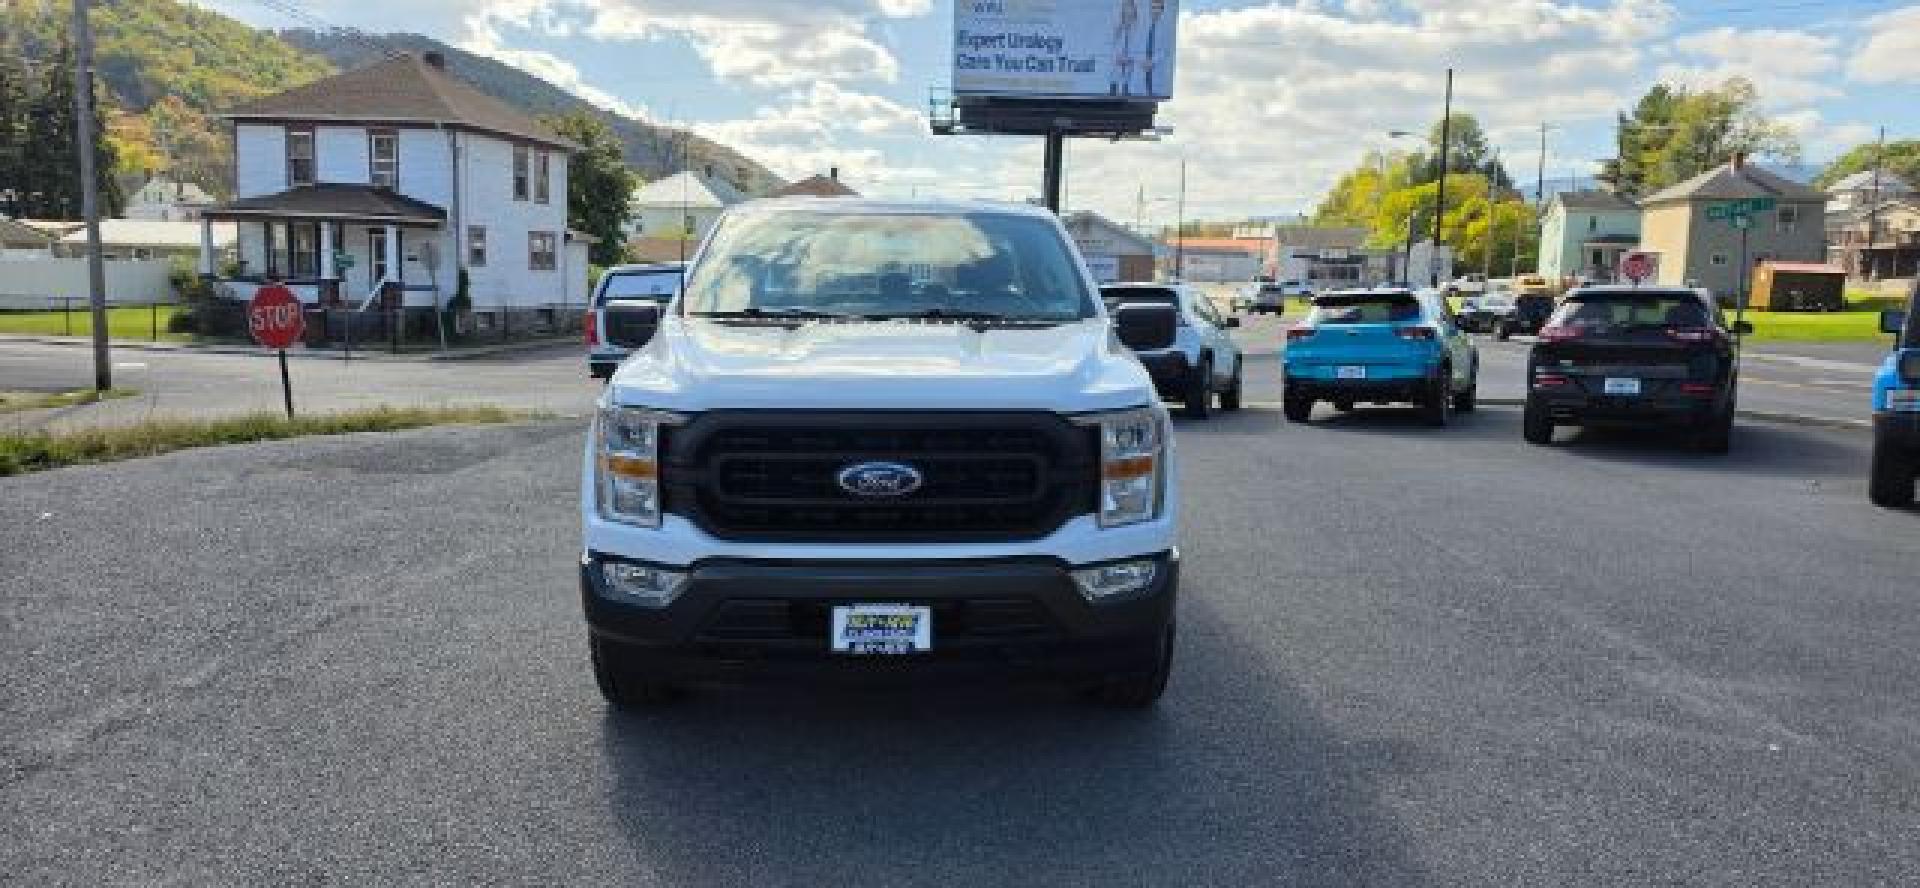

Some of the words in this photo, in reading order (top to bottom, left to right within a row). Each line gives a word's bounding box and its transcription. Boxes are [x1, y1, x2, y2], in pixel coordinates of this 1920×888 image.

[959, 31, 1006, 50] Expert
[1008, 33, 1063, 53] Urology
[958, 54, 991, 70] Care
[995, 54, 1023, 71] You
[1026, 56, 1054, 72] Can
[1058, 57, 1096, 72] Trust
[252, 304, 298, 330] STOP
